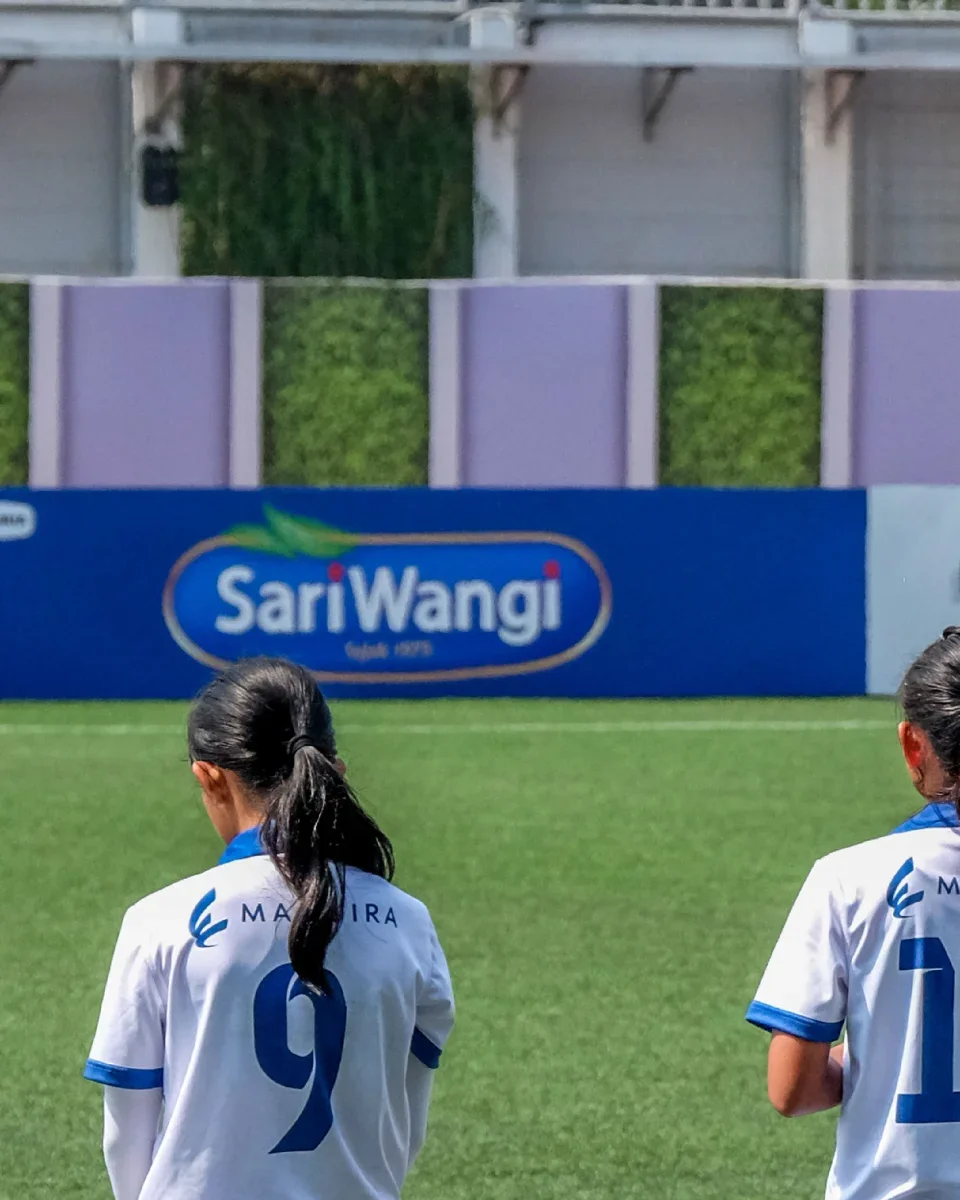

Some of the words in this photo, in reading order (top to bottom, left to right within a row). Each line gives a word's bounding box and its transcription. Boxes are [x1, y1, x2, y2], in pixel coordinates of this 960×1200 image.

[214, 559, 563, 647] SariWangi
[241, 902, 398, 929] MAIRA
[253, 962, 347, 1155] 9
